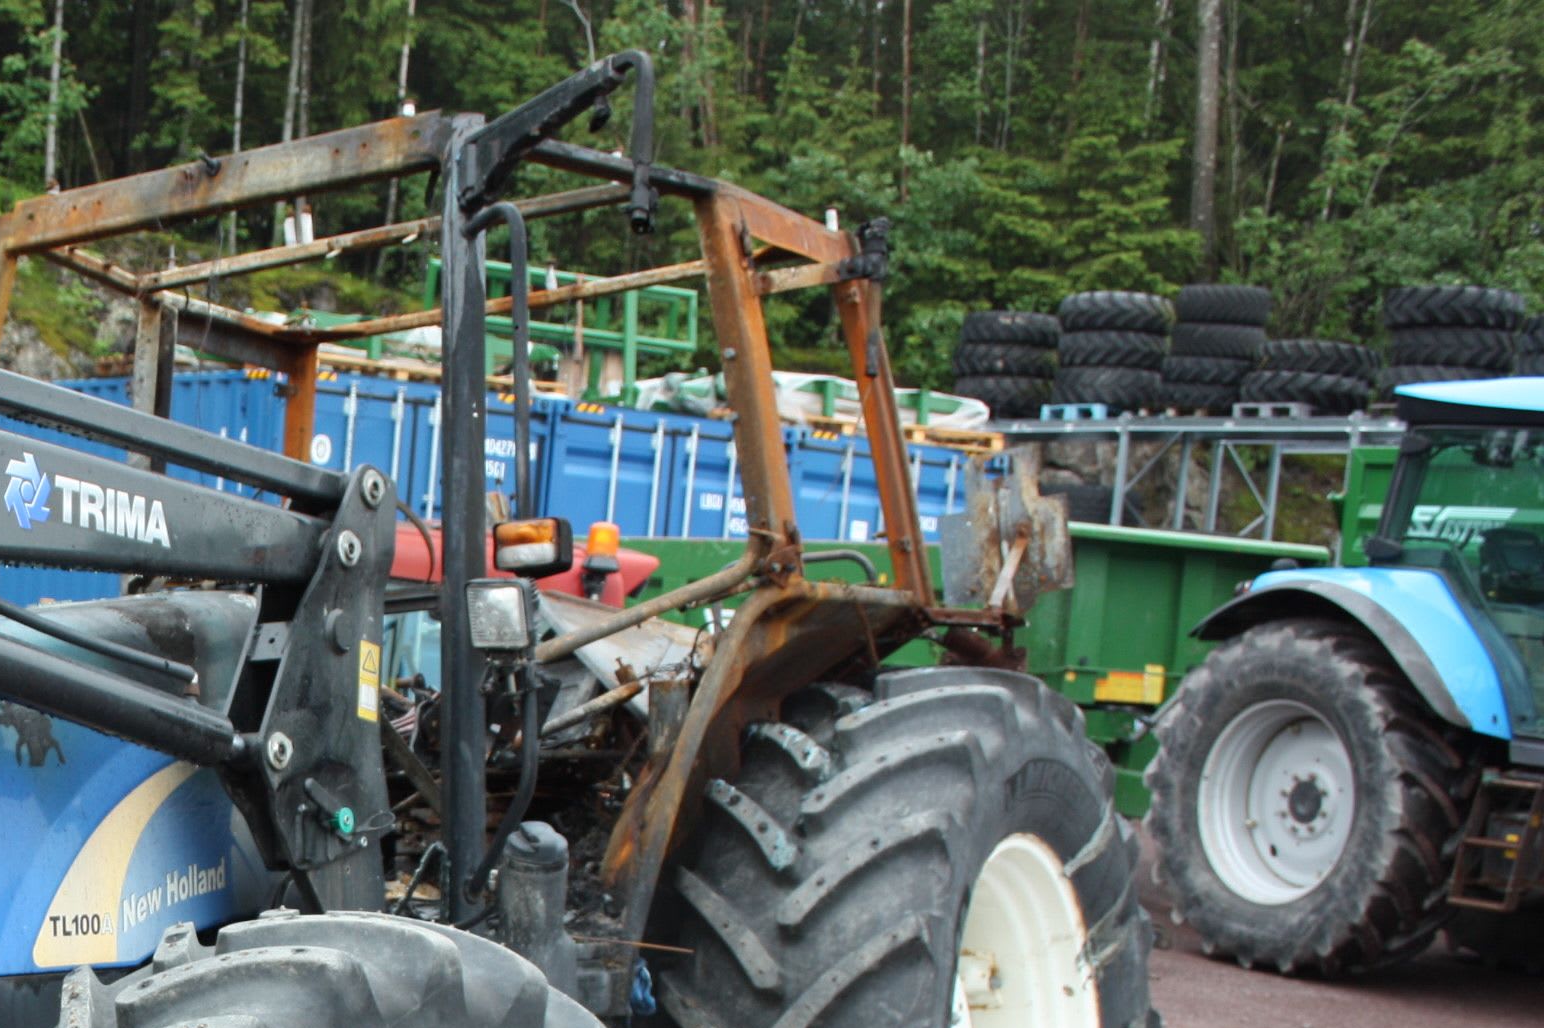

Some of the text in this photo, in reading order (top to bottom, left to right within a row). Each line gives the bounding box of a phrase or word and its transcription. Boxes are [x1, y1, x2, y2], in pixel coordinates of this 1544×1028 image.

[55, 464, 171, 549] TRIMA
[49, 912, 114, 937] TL100A
[123, 856, 226, 933] New Holland
